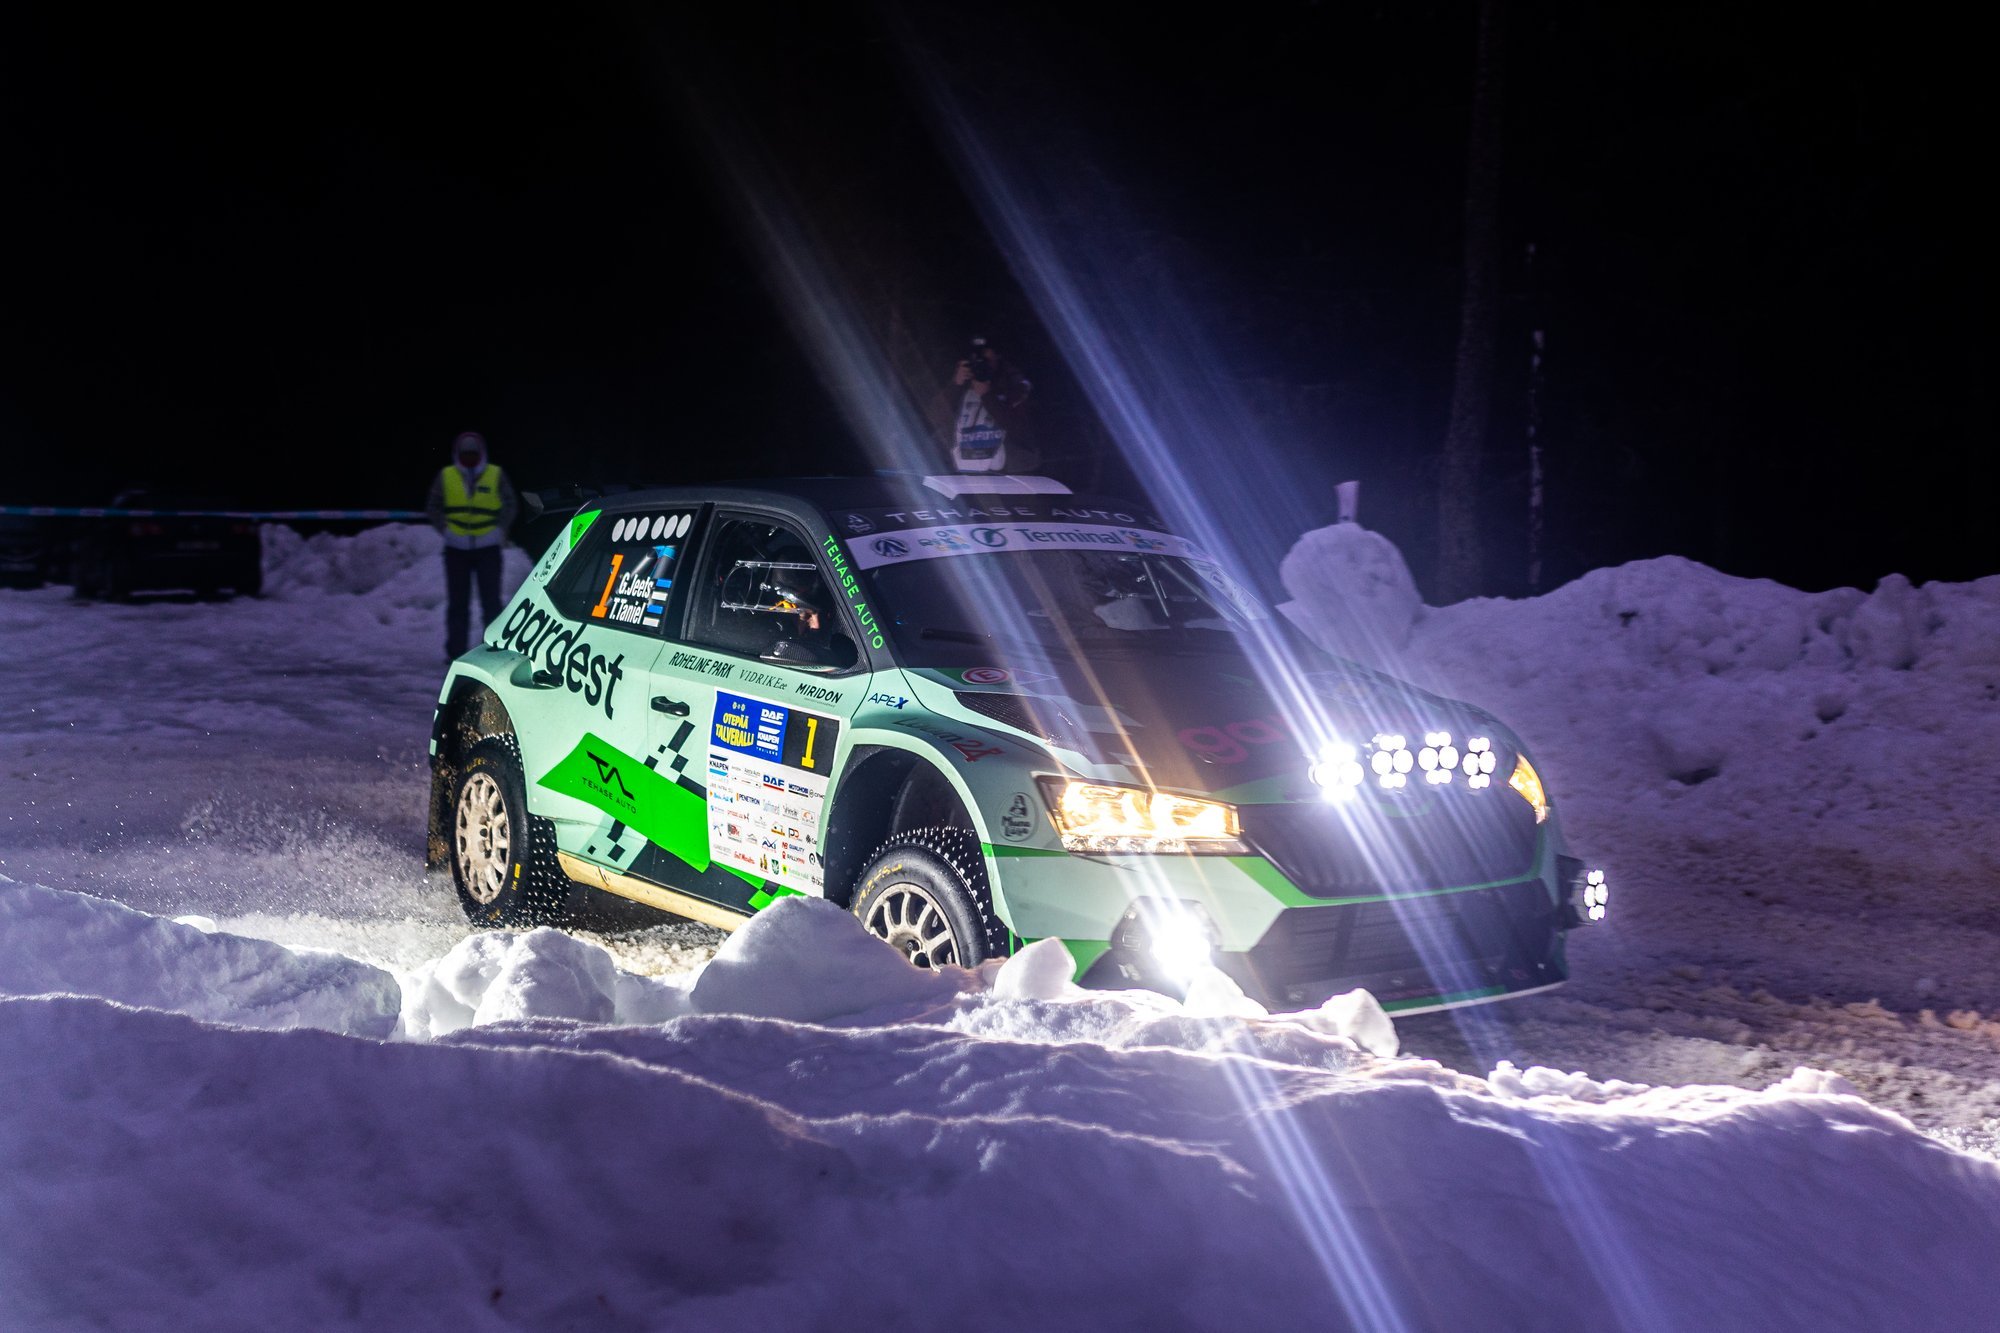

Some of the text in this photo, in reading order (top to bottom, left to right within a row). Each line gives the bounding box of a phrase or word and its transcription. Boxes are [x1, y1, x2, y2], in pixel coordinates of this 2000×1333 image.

[885, 506, 1136, 523] TEHASE AUTO
[1014, 528, 1125, 545] Terminal
[591, 554, 624, 618] 1
[618, 572, 654, 600] G.Jeets
[823, 535, 884, 649] TEHASE AUTO
[608, 597, 647, 625] T.Taniel
[487, 598, 625, 720] gardest
[668, 651, 735, 679] ROHELINE PARK
[795, 682, 844, 704] MIRIDON
[868, 692, 909, 709] APEX
[722, 712, 749, 730] OTEPÄÄ
[761, 708, 785, 721] DAF
[715, 723, 755, 747] TALVERALLI
[757, 732, 780, 745] KNAPEN
[801, 717, 818, 769] 1
[762, 774, 785, 787] DAF
[582, 776, 637, 815] TEHASE AUTO
